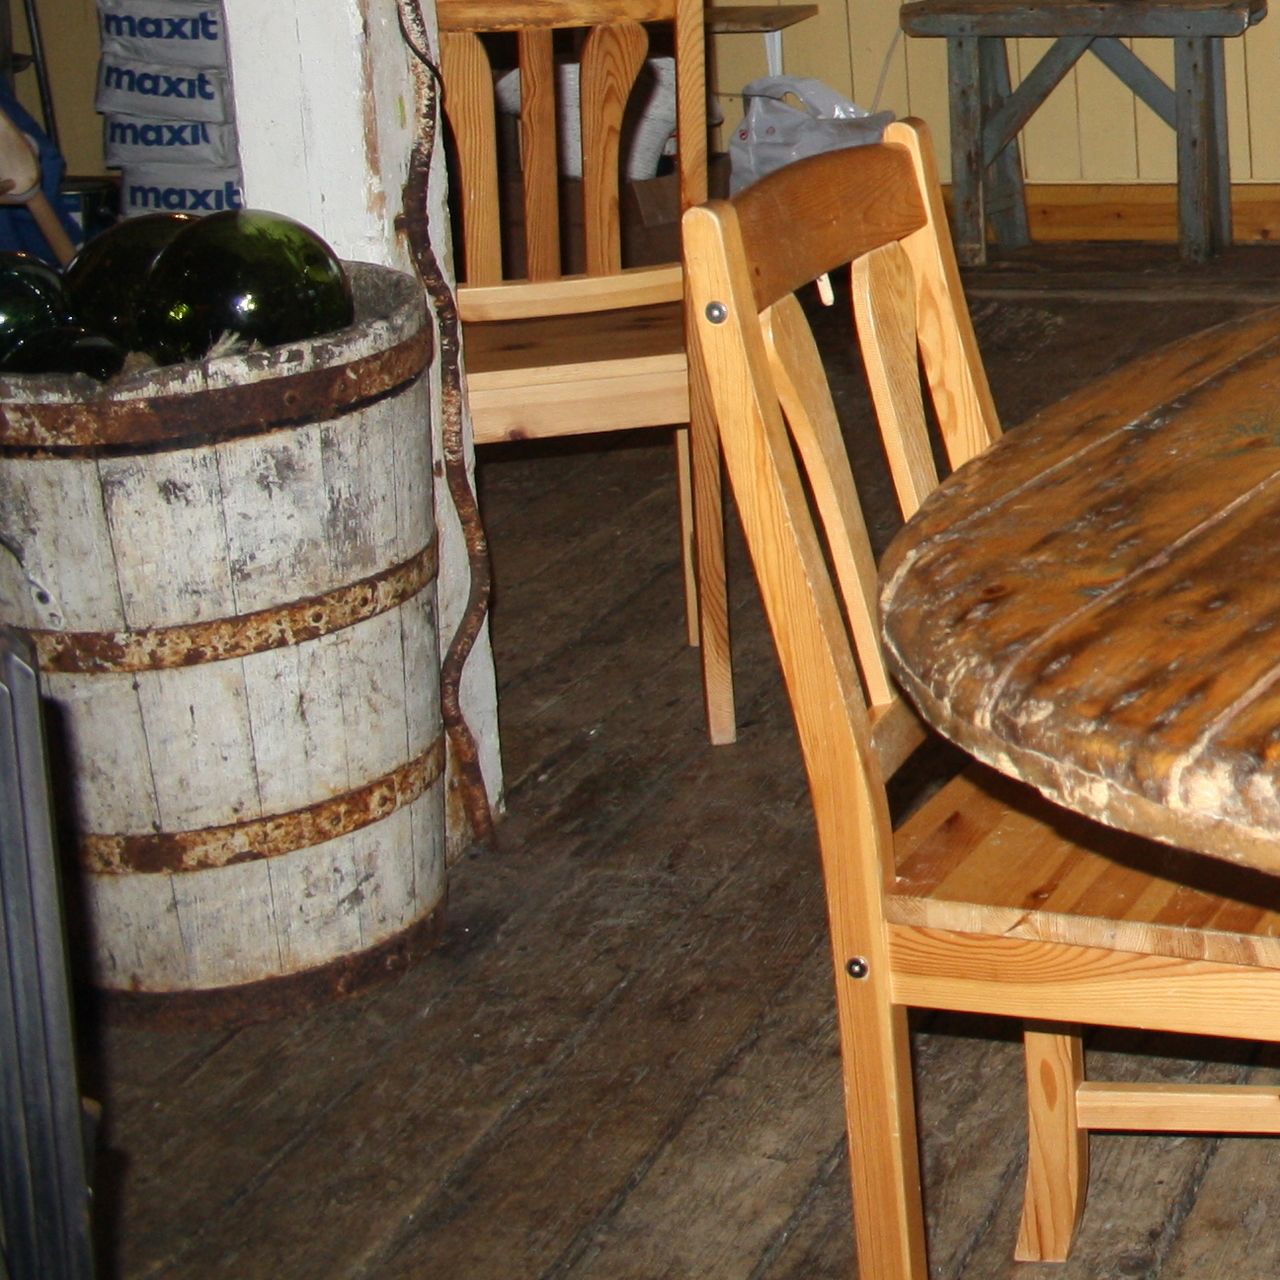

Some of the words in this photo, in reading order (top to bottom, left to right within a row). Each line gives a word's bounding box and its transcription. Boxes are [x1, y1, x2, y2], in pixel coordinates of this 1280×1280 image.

[104, 11, 218, 41] maxit
[105, 64, 215, 100] maxit
[129, 181, 242, 210] maxit
